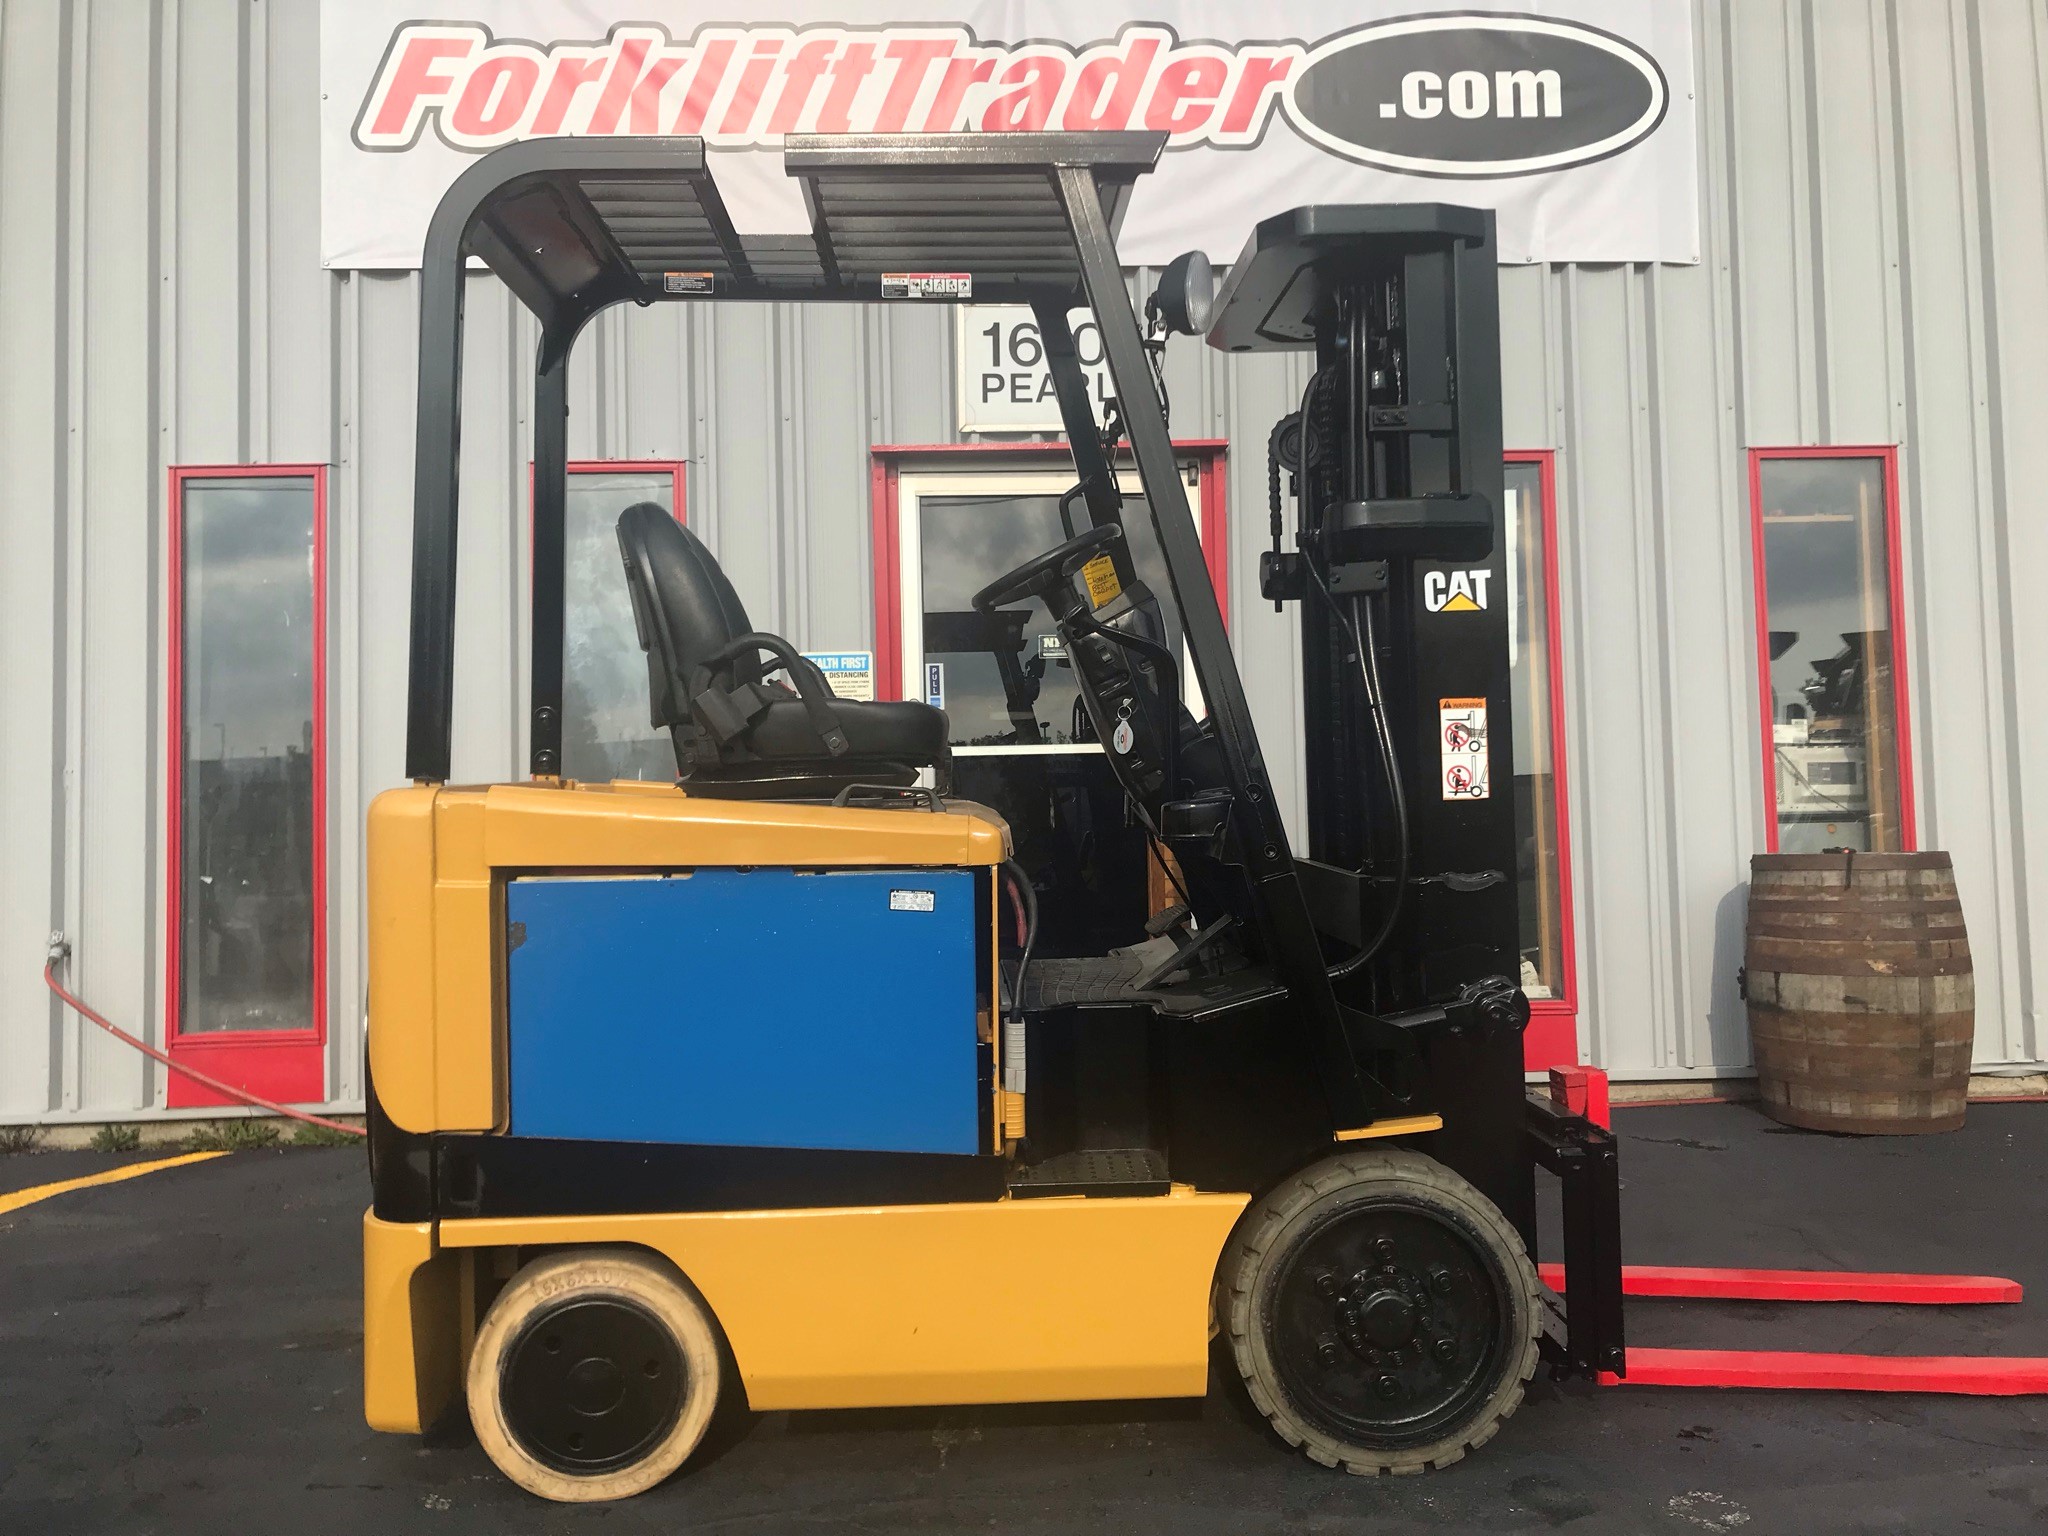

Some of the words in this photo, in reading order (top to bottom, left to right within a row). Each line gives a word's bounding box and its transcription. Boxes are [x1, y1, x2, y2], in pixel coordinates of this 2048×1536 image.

[1379, 66, 1563, 119] .com
[982, 322, 1105, 367] 160
[982, 373, 1107, 403] PEAL
[1424, 569, 1492, 612] CAT
[808, 657, 839, 669] EALTH
[841, 656, 867, 669] FIRST
[829, 671, 869, 679] DISTANCING
